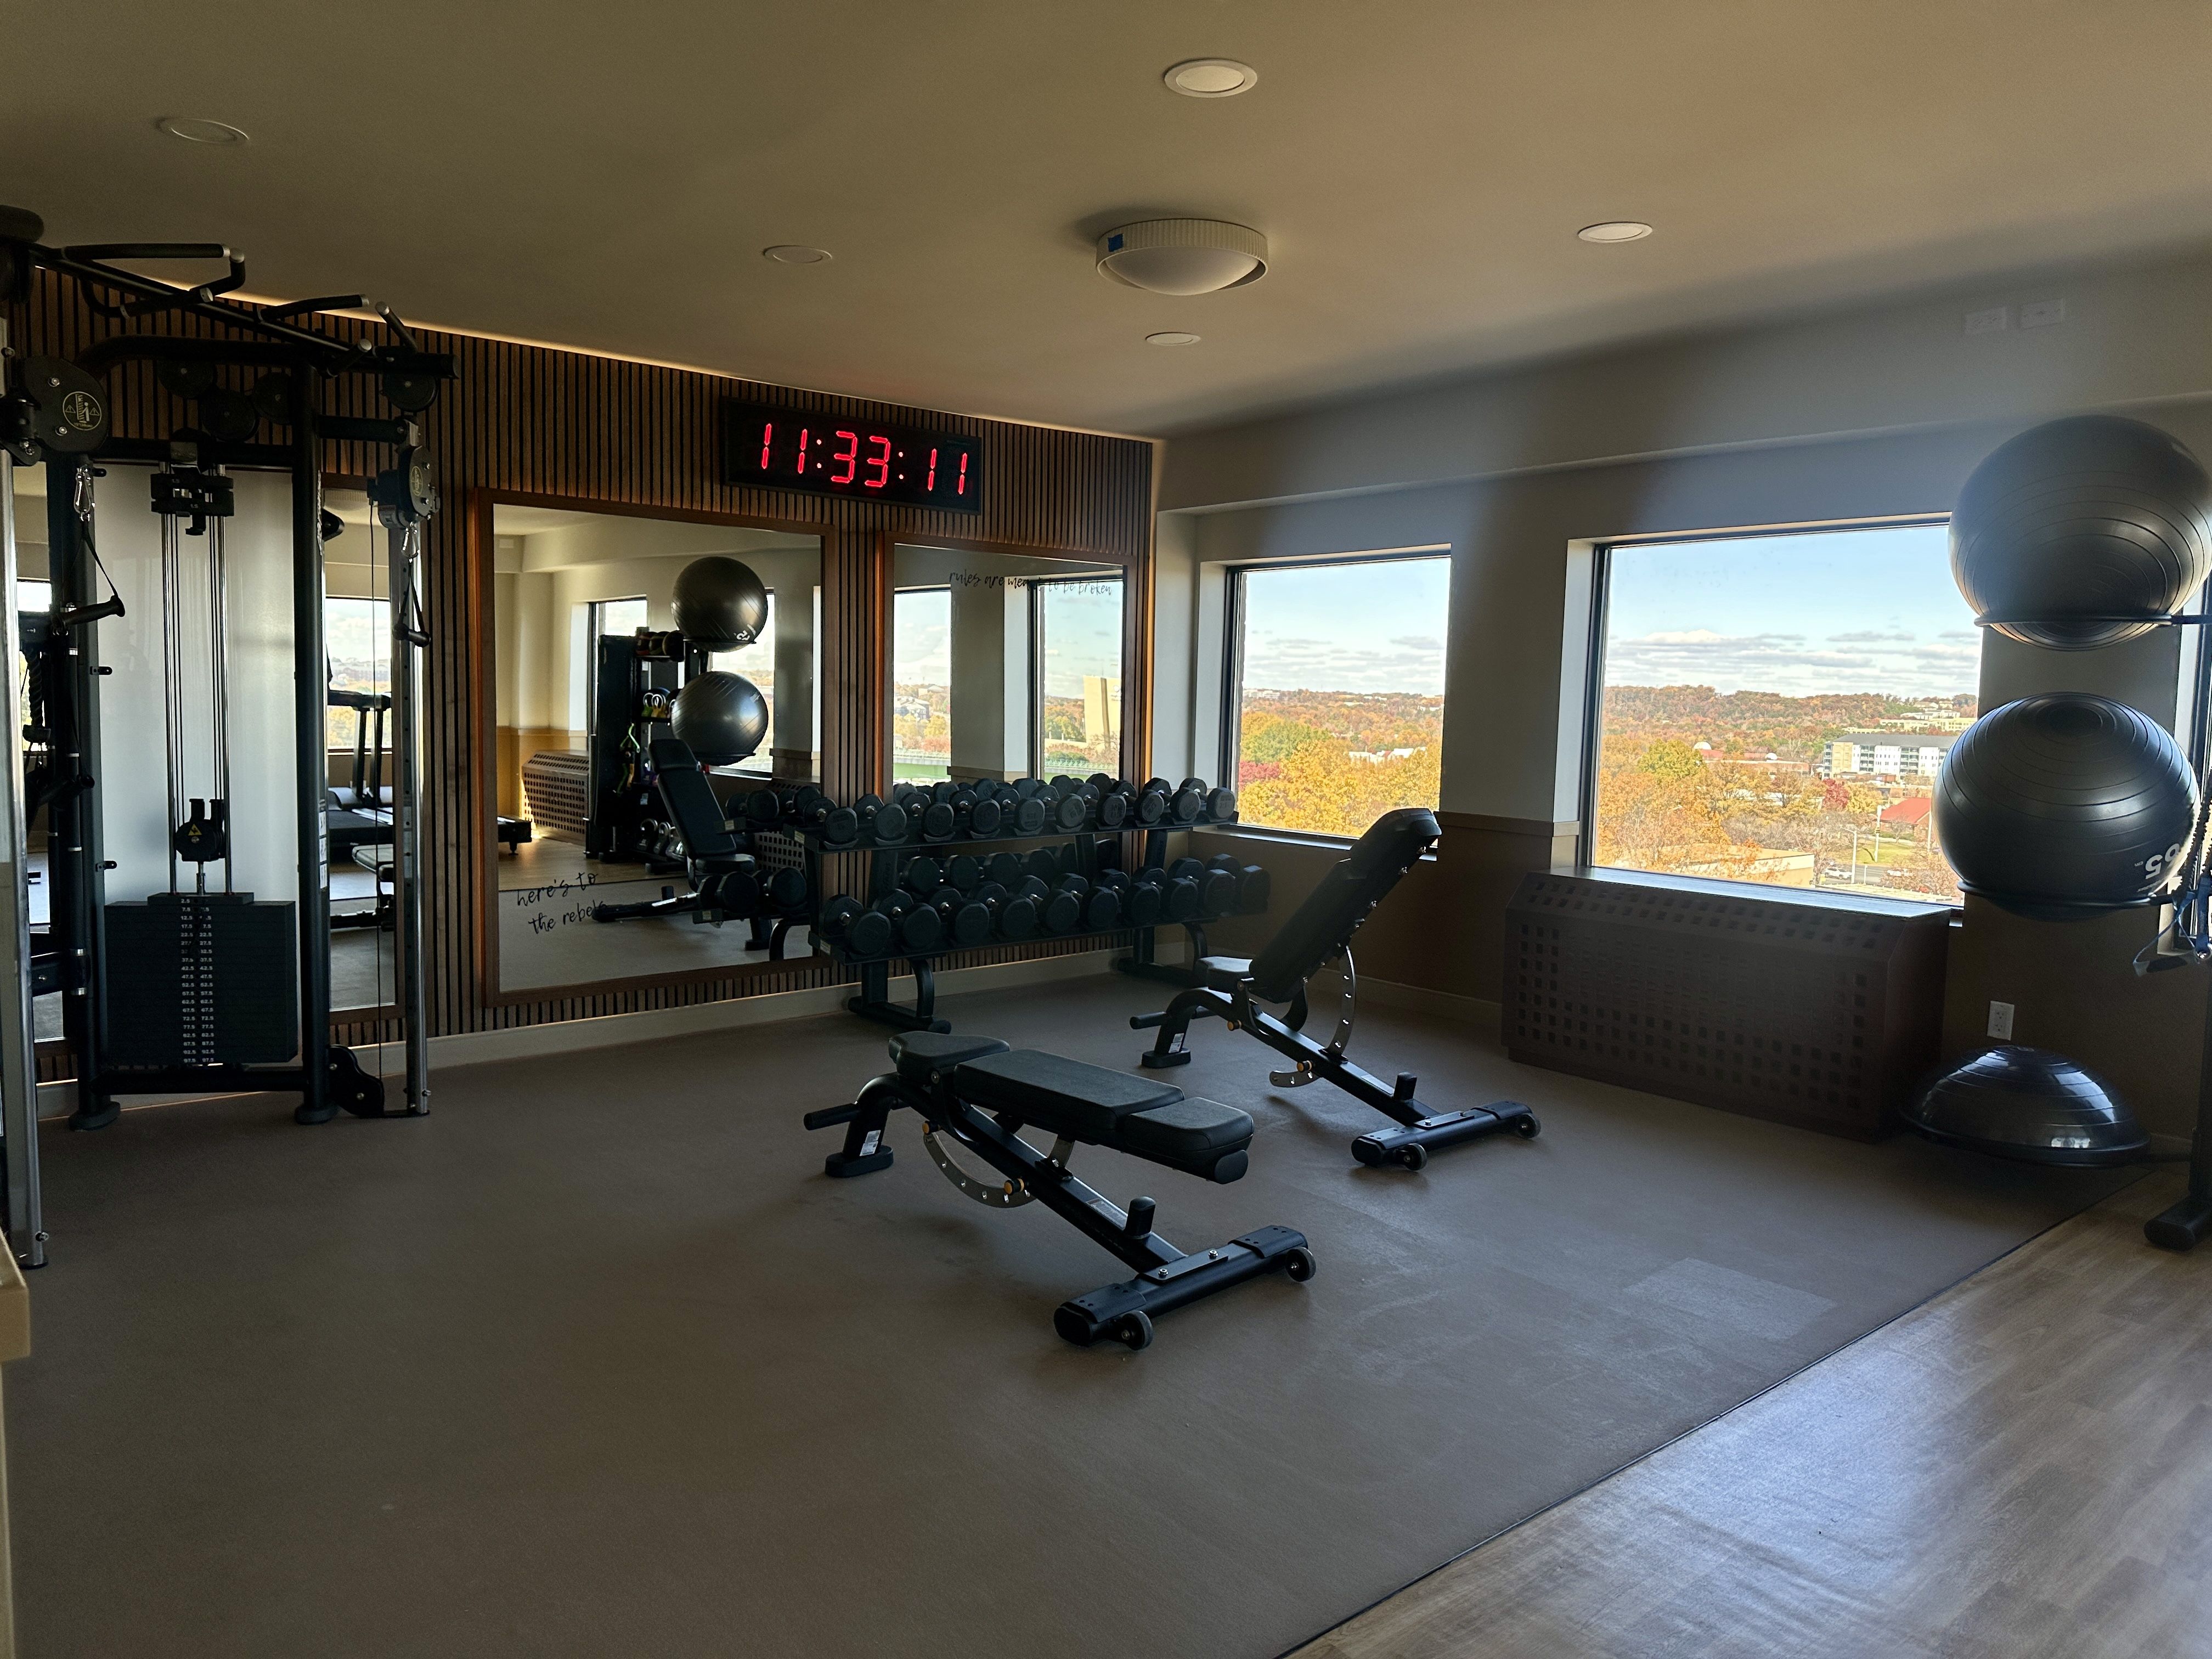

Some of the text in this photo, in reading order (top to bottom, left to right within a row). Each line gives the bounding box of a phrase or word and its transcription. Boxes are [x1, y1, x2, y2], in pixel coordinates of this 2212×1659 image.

[761, 423, 968, 495] 11:33:11
[949, 569, 981, 587] rules
[985, 577, 1005, 589] are
[1079, 580, 1111, 595] broken
[517, 872, 598, 906] here's to
[528, 912, 555, 934] the
